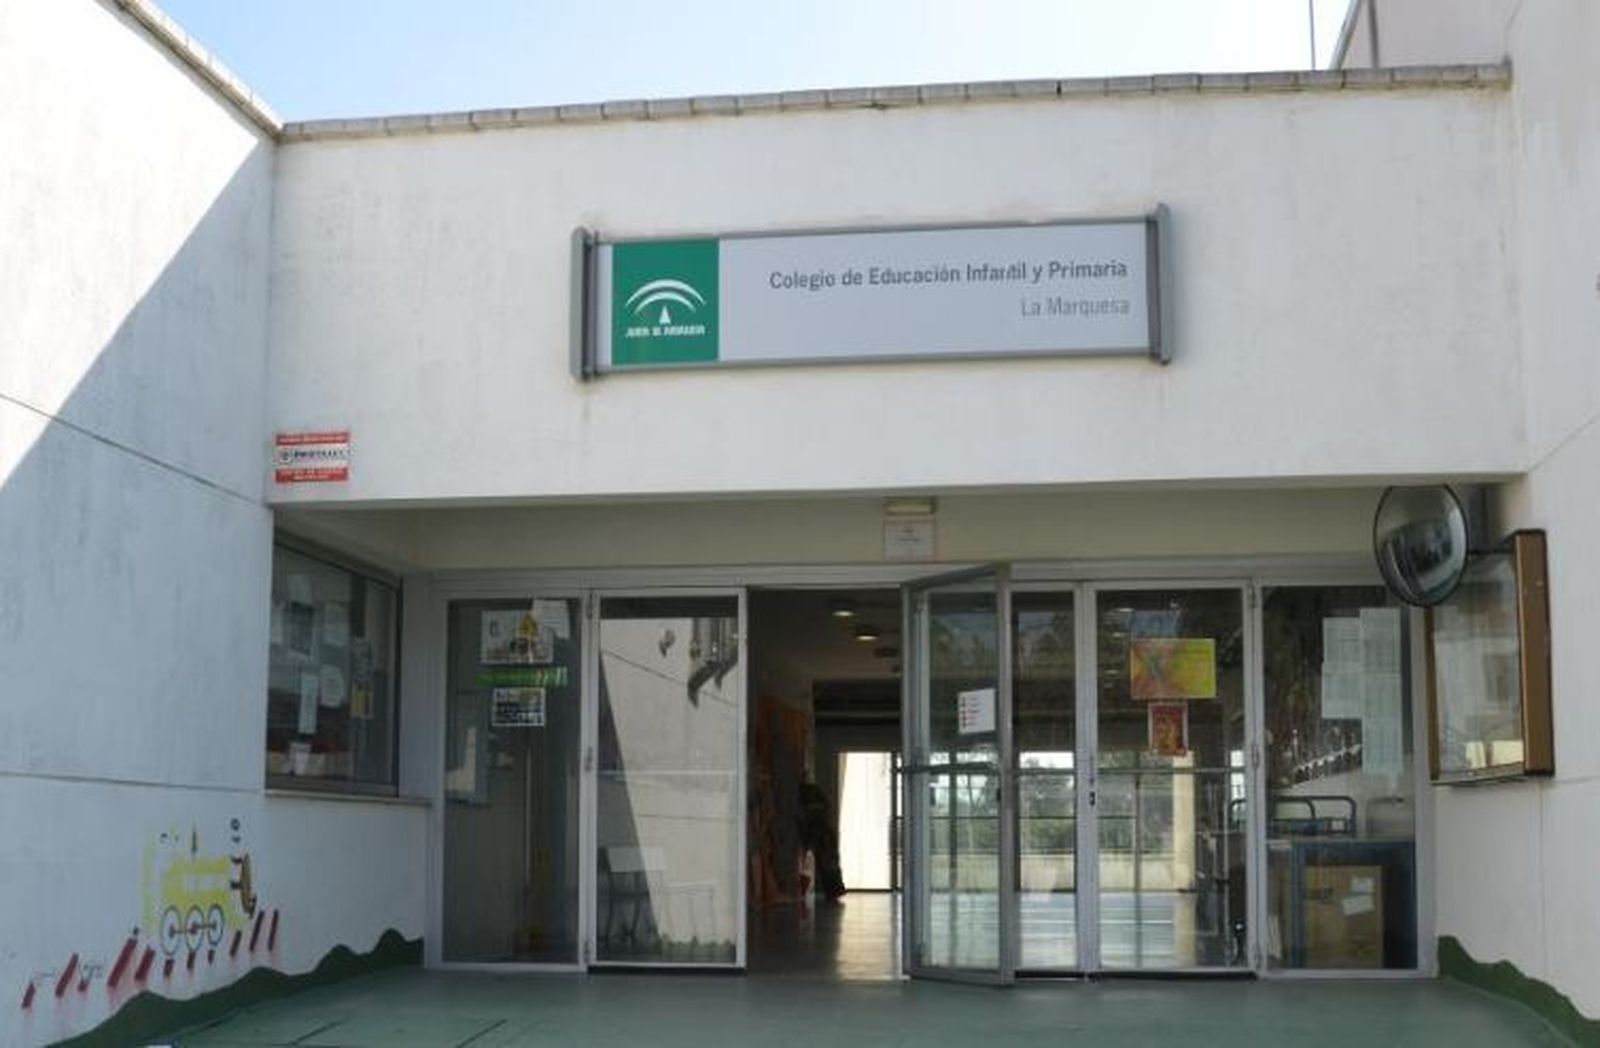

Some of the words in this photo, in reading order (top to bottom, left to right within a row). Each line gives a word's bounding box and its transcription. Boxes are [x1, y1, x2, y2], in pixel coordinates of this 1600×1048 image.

[769, 270, 836, 291] Colegio
[841, 269, 863, 286] de
[868, 264, 961, 285] Educación
[966, 261, 1026, 281] Infantil
[1033, 264, 1043, 284] y
[1049, 260, 1128, 279] Primaria
[1021, 299, 1041, 316] La
[1048, 297, 1130, 318] Marquesa
